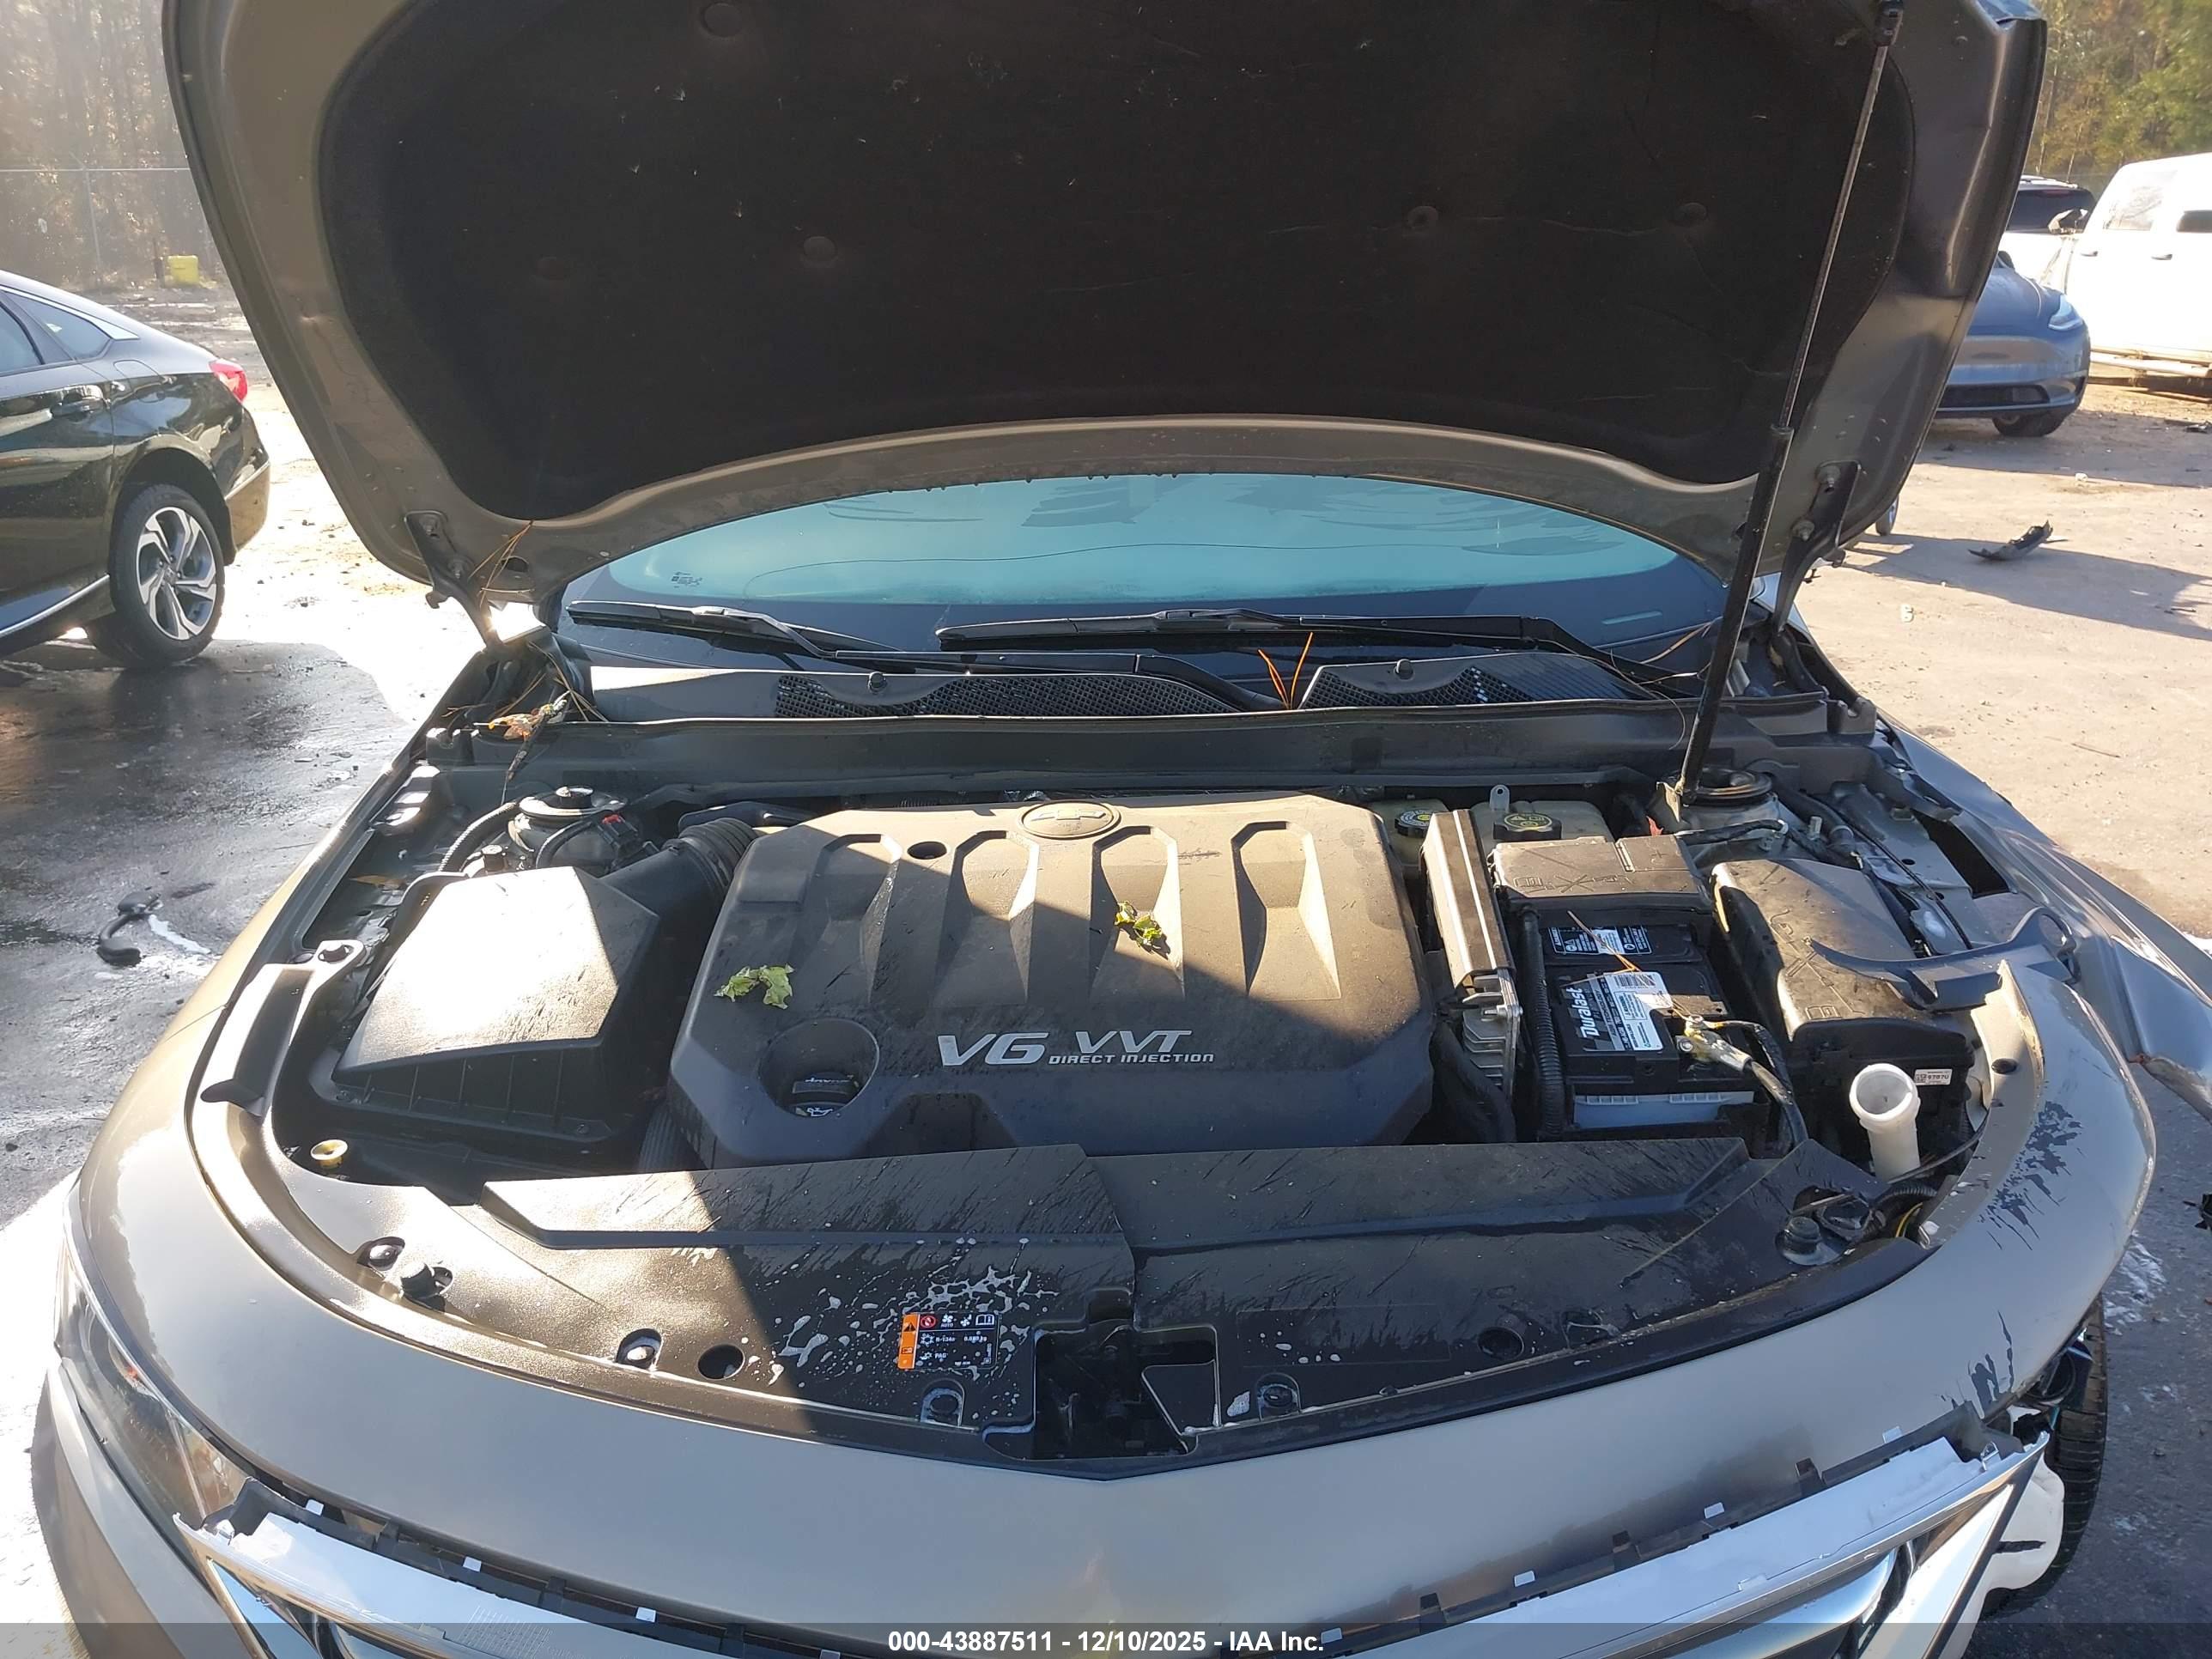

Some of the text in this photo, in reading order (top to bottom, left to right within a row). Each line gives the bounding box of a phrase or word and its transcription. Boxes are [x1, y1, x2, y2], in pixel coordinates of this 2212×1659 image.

[1566, 987, 1601, 1038] Duralast
[938, 1030, 1193, 1066] V6 VVT
[1048, 1054, 1116, 1066] DIRECT
